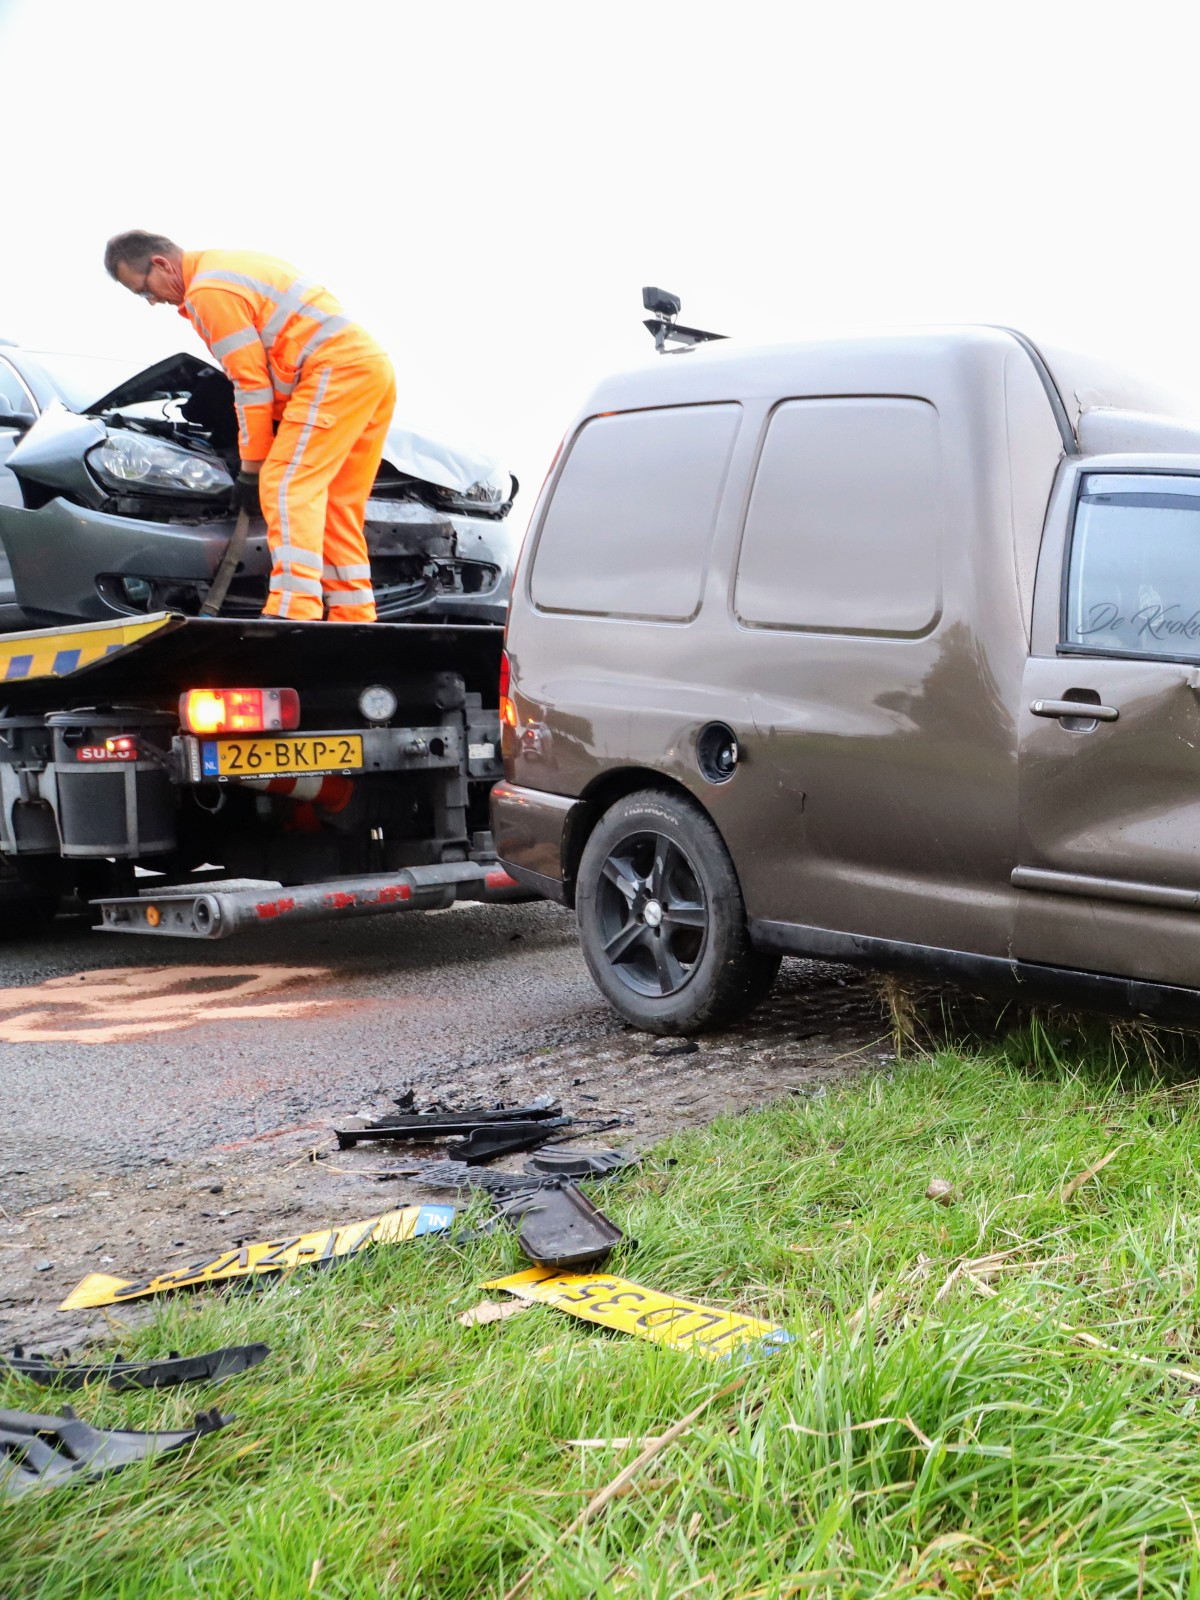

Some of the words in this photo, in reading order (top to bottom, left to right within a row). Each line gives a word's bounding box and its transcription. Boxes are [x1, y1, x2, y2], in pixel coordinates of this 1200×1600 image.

[1076, 602, 1125, 635] De
[204, 761, 217, 770] NL
[227, 740, 353, 769] 26-BKP-2
[423, 1213, 448, 1228] NL
